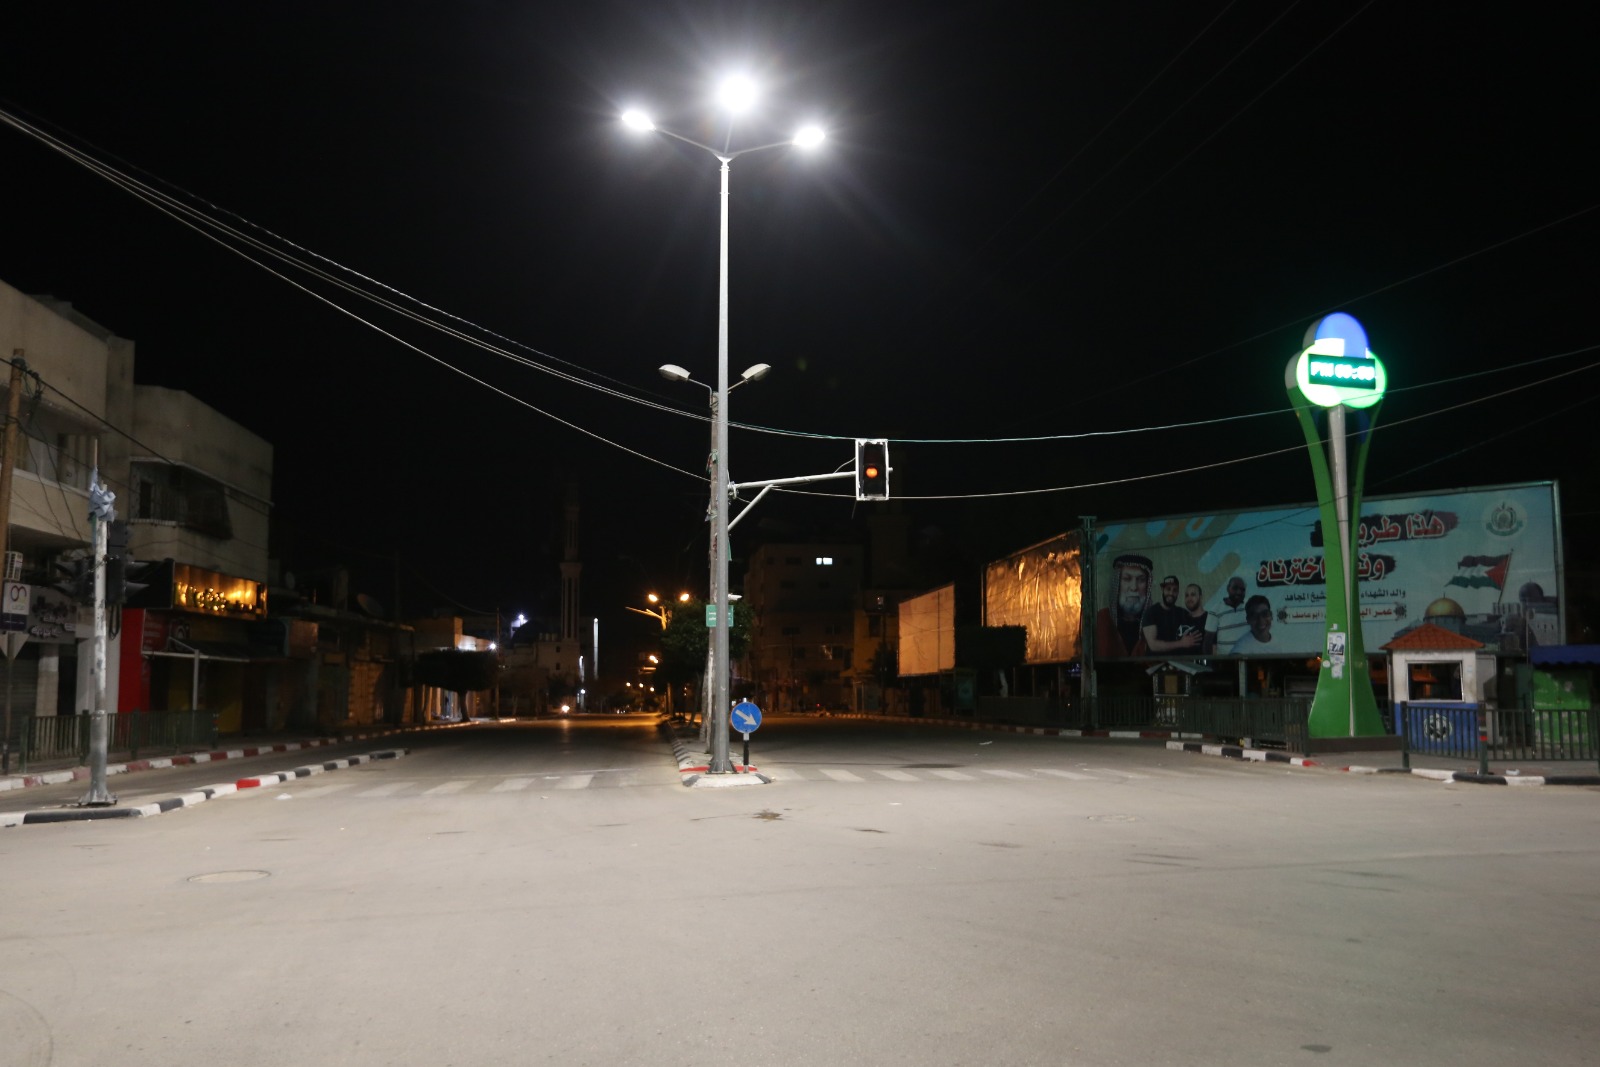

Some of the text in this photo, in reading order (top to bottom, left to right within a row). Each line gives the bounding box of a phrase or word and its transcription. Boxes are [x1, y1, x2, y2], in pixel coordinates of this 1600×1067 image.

[1405, 514, 1445, 539] هذا
[1257, 556, 1326, 585] اخترناه
[1360, 588, 1388, 600] الشهداء
